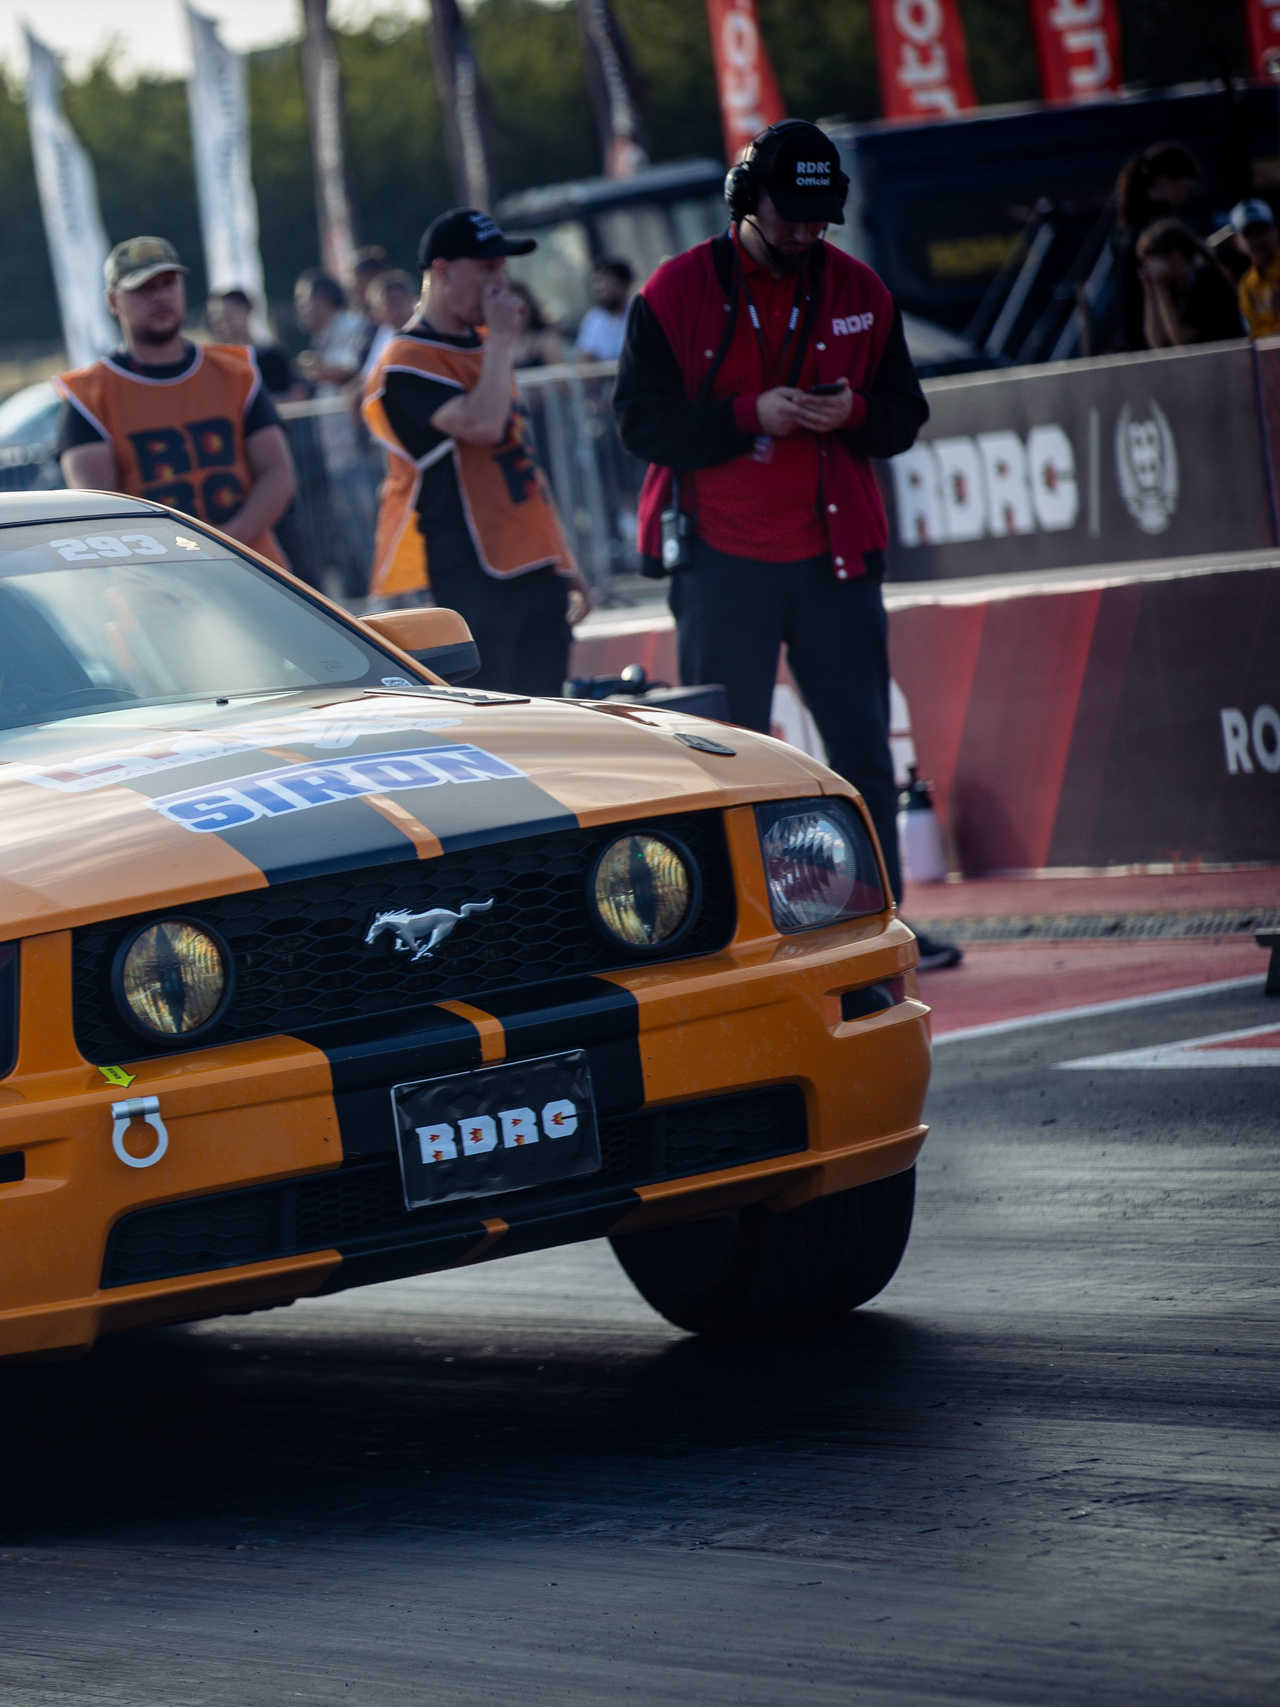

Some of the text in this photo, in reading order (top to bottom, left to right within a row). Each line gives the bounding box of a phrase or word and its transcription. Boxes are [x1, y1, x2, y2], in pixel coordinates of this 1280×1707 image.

[796, 161, 831, 174] RDRC
[796, 176, 831, 186] Official
[128, 418, 235, 484] RD
[889, 424, 1080, 549] RDRC
[49, 534, 169, 562] 293
[164, 749, 522, 832] SIRON
[416, 1098, 579, 1165] RDRC
